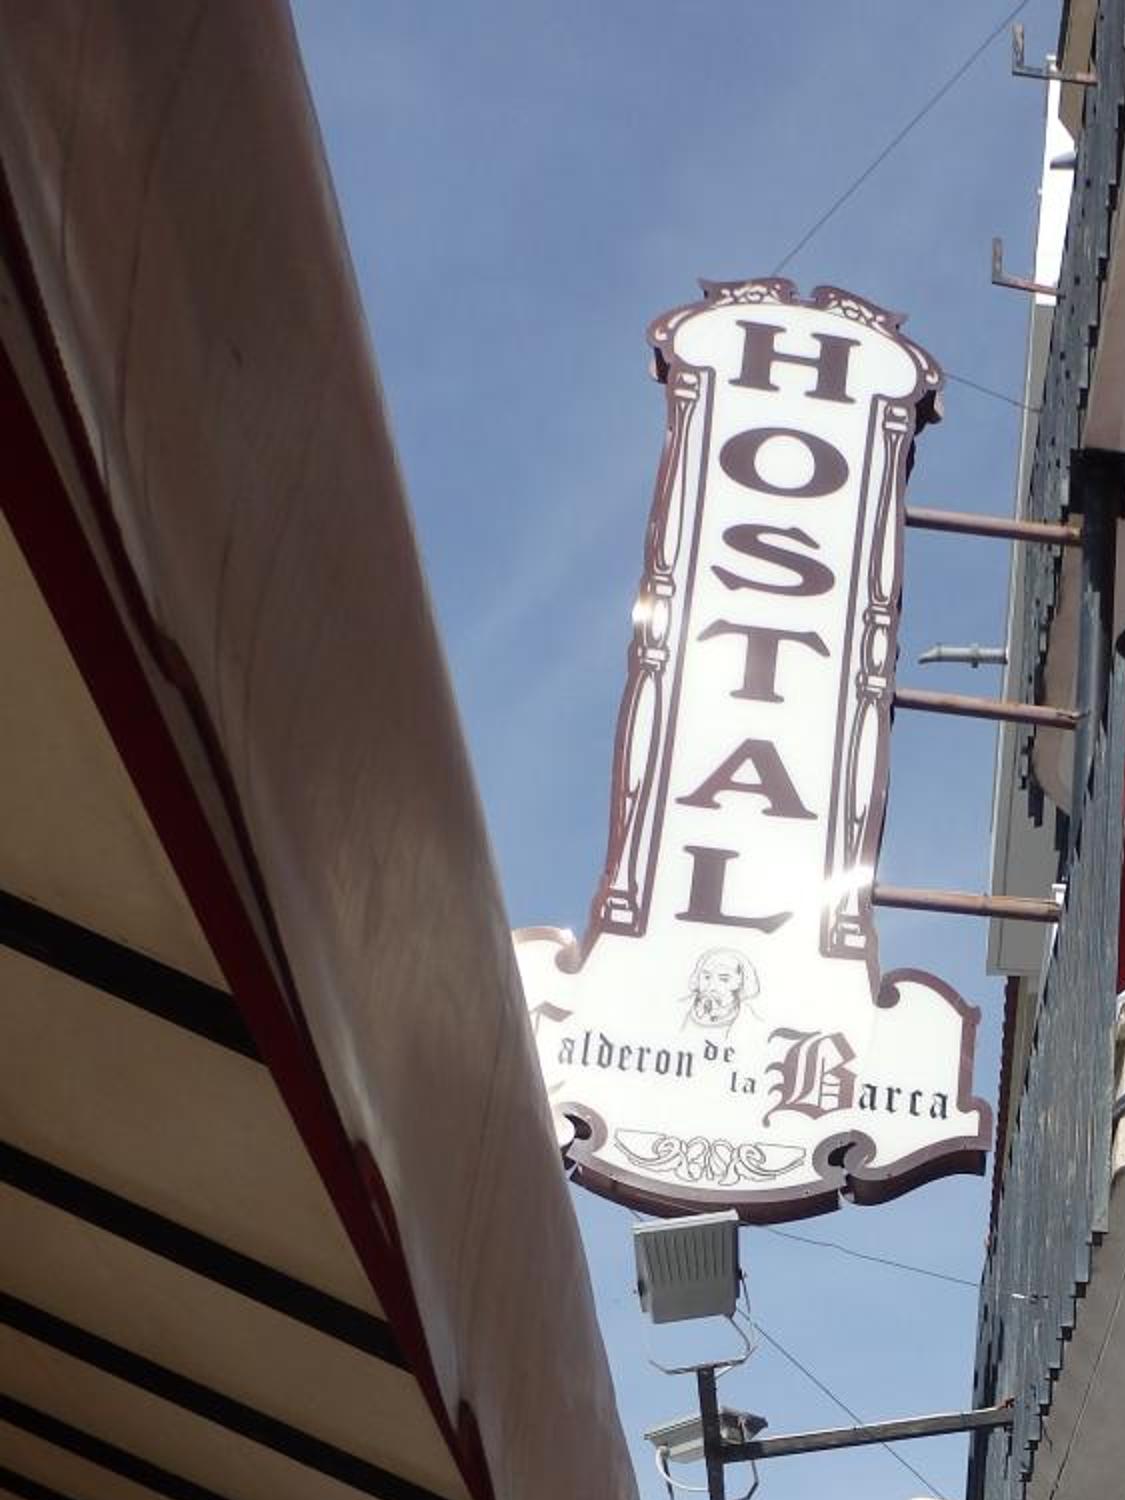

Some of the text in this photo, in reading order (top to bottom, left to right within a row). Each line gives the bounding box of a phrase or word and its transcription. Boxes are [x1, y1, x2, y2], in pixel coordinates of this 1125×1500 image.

[675, 319, 860, 935] HOSTAL
[703, 1039, 736, 1063] de
[730, 1070, 756, 1095] la
[763, 1027, 951, 1127] Barca
